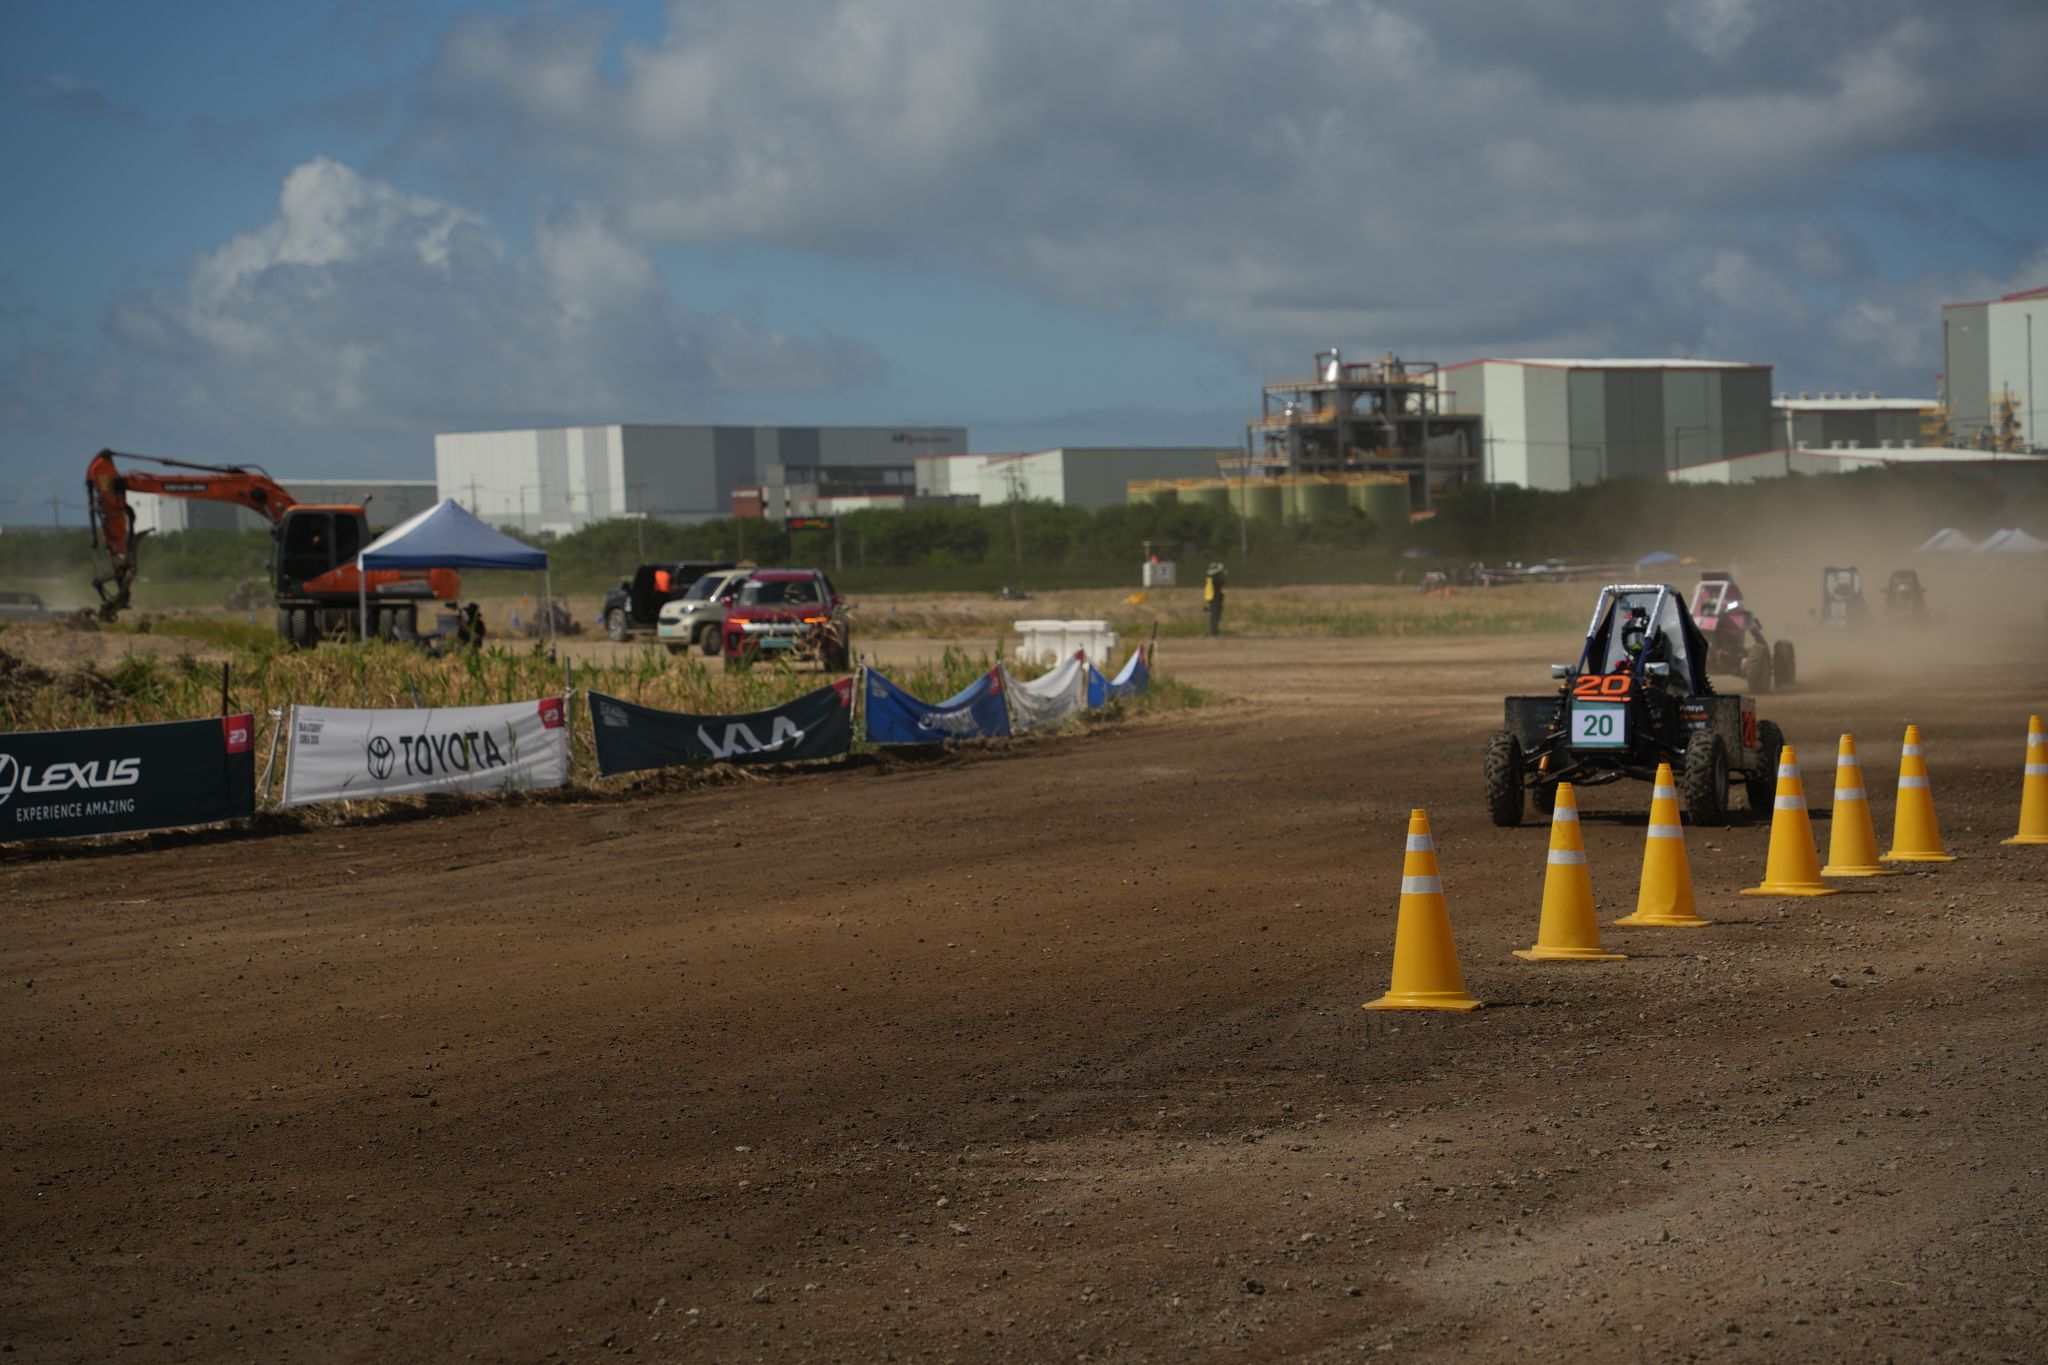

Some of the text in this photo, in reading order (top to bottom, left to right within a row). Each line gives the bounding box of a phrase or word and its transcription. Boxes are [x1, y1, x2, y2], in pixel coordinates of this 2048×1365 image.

[1573, 674, 1632, 696] 20
[1583, 714, 1613, 737] 20
[399, 730, 507, 776] TOYOTA
[20, 757, 142, 793] LEXUS
[16, 798, 136, 823] EXPERIENCE AMAZING
